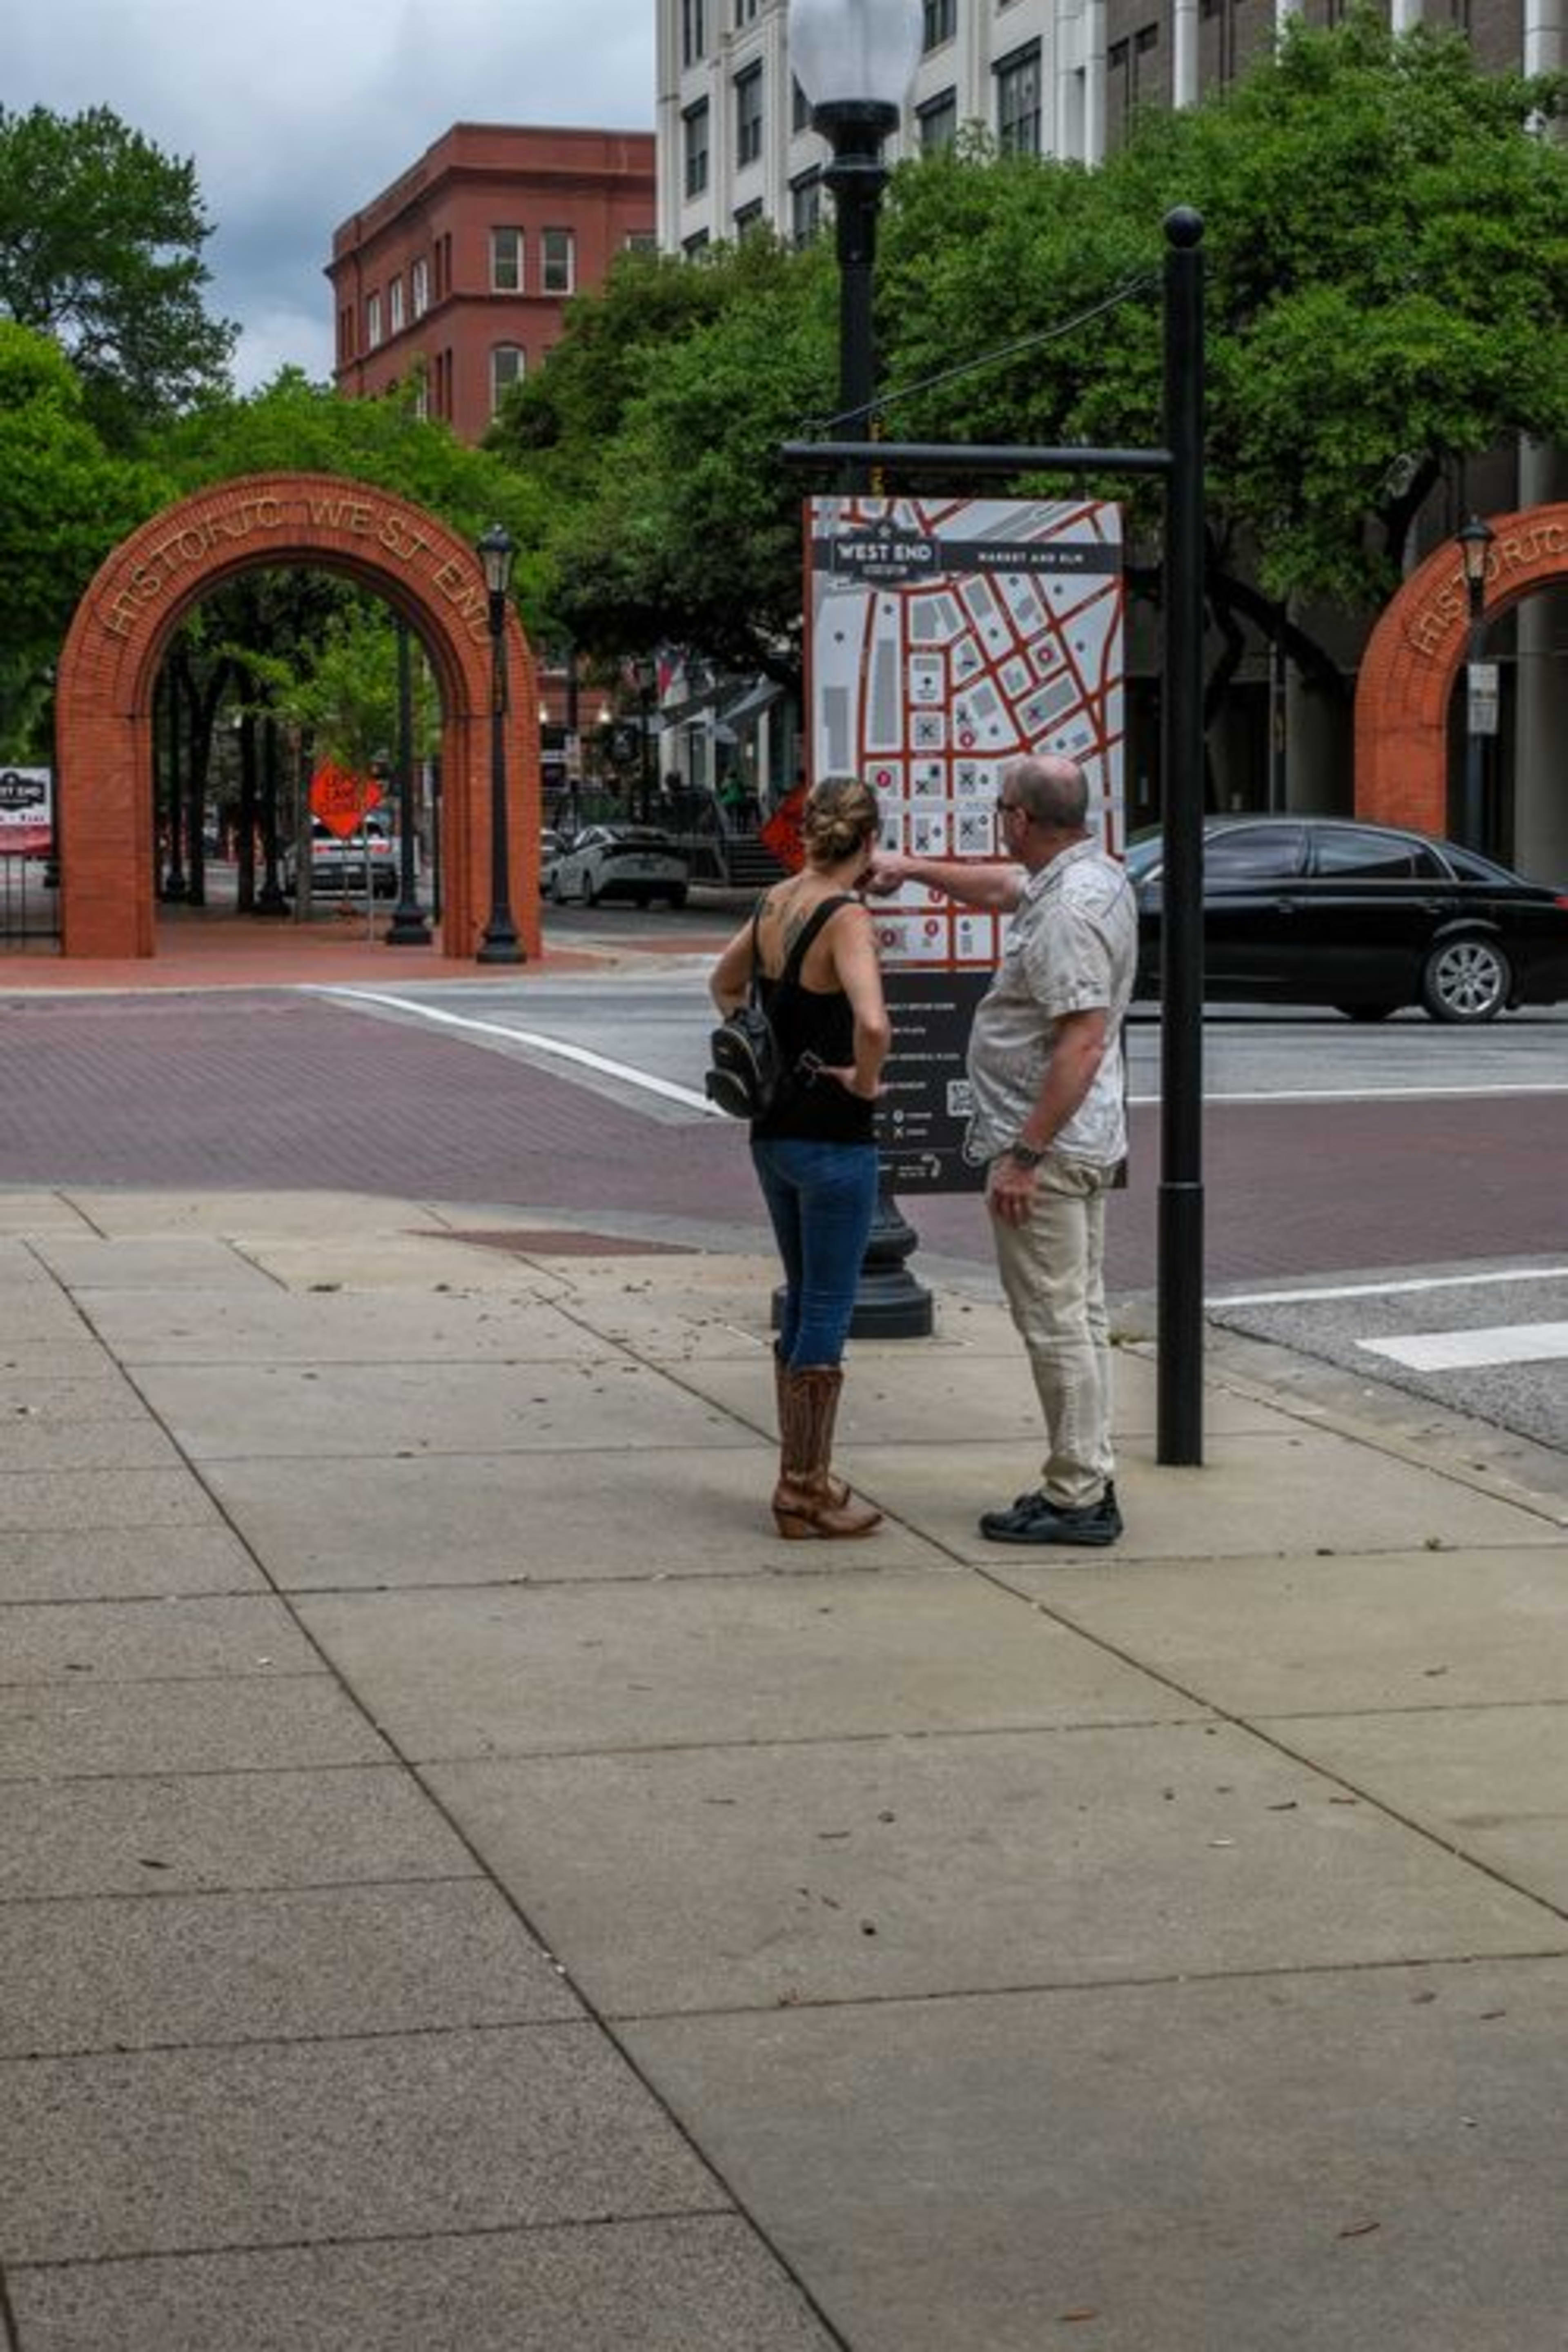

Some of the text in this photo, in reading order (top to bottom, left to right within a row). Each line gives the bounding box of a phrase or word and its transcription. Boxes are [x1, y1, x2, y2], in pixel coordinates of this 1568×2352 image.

[103, 497, 282, 636] HISTORIC
[307, 500, 429, 559] WEST
[837, 543, 932, 561] WEST END
